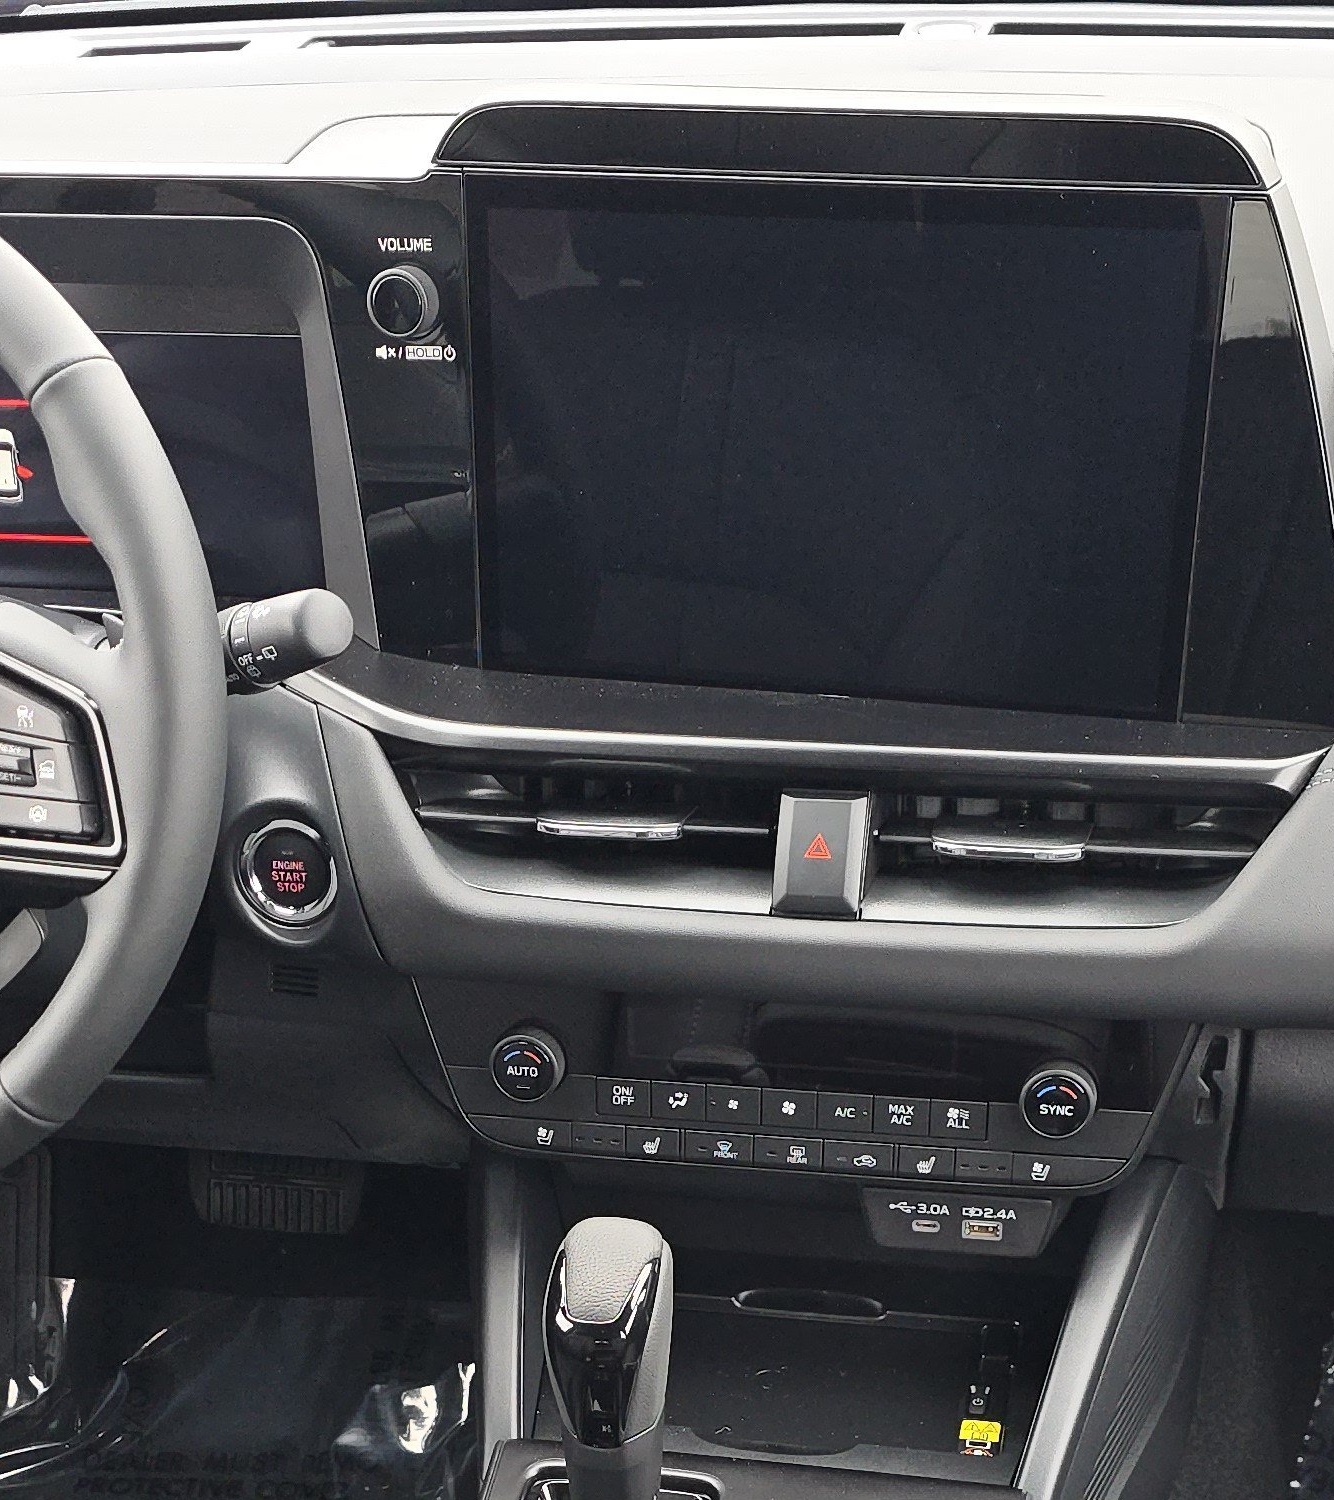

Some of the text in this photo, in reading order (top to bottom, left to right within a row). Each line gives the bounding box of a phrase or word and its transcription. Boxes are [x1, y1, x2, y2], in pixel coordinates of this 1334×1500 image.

[377, 237, 433, 252] VOLUME
[406, 346, 442, 359] HOLD
[237, 653, 254, 666] OFF
[272, 860, 305, 871] ENGINE
[271, 871, 308, 883] START
[276, 882, 306, 893] STOP
[506, 1066, 538, 1078] AUTO
[612, 1085, 634, 1096] ON/
[612, 1095, 635, 1106] OFF
[834, 1106, 856, 1119] A/C
[888, 1104, 915, 1115] MAX
[1039, 1103, 1075, 1117] SYNC
[890, 1114, 912, 1126] A/C
[946, 1117, 971, 1130] ALL
[713, 1150, 738, 1161] FRONT
[786, 1155, 807, 1165] REAR
[916, 1203, 950, 1216] 3.0A
[983, 1208, 1017, 1220] 2.4A
